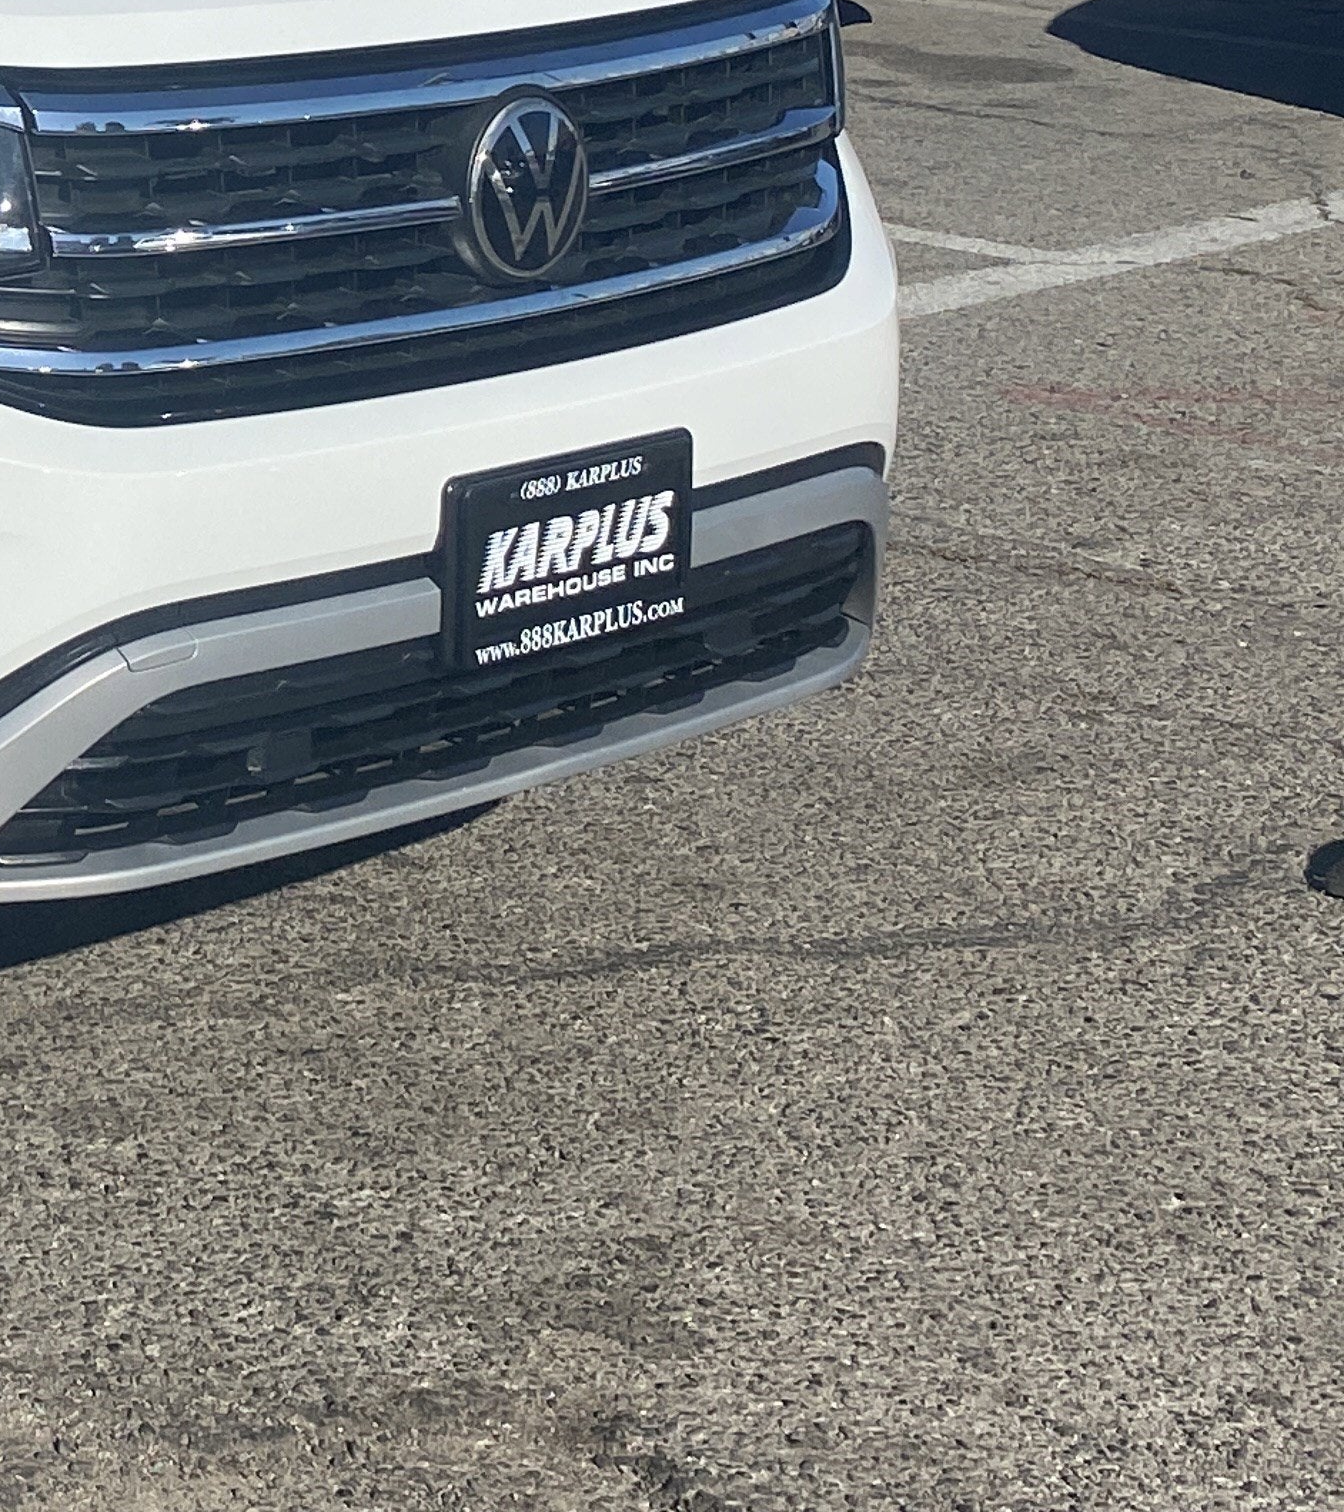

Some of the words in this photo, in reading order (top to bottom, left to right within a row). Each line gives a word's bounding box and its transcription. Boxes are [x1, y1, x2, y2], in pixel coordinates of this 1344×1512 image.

[520, 475, 562, 500] (888)
[565, 456, 643, 491] KARPLUS
[476, 490, 675, 595] KARPLUS
[475, 565, 626, 618] WAREHOUSE
[633, 553, 675, 579] INC
